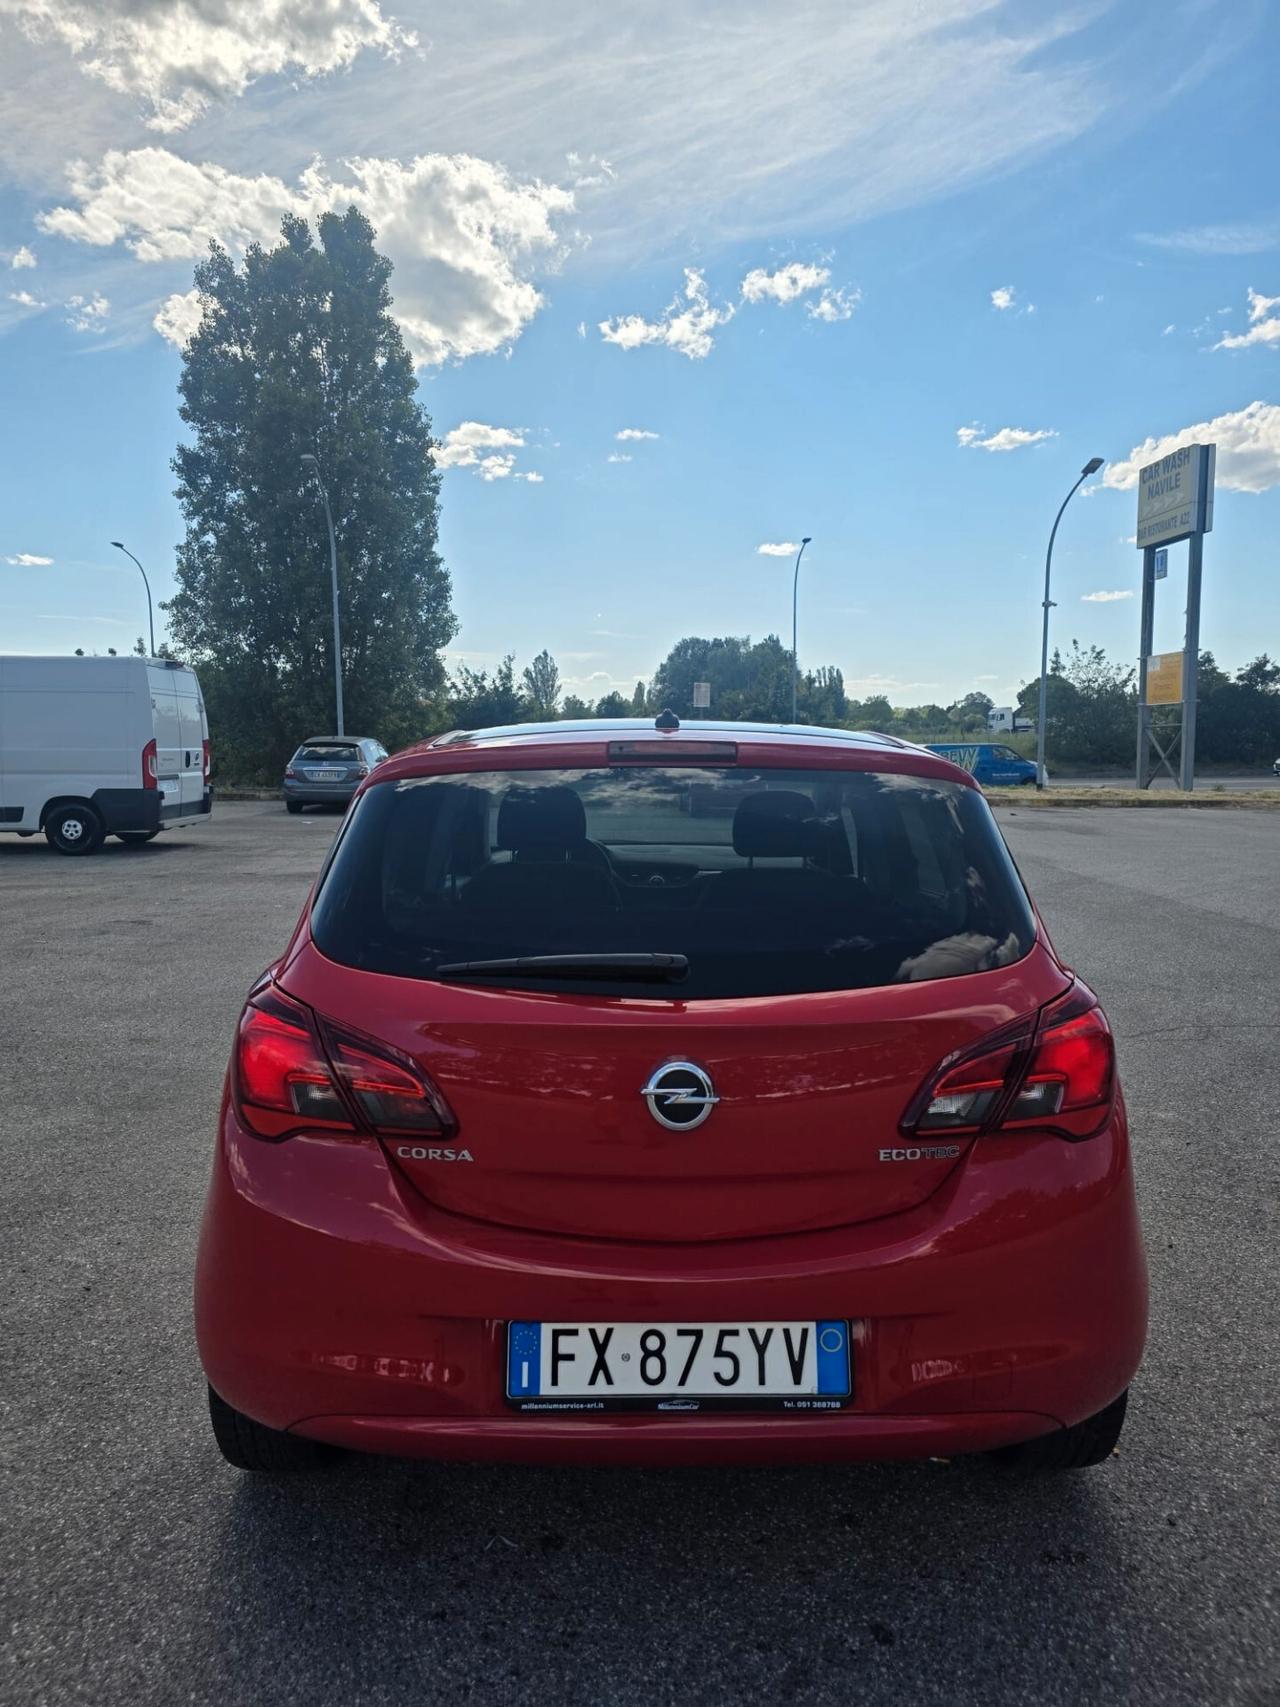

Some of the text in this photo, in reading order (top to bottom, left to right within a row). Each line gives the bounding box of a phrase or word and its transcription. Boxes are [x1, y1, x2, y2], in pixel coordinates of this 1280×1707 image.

[1142, 450, 1190, 484] CAR WASH
[1148, 472, 1181, 500] NAVILE
[397, 1146, 474, 1162] CORSA
[879, 1146, 960, 1161] ECOTEC
[551, 1327, 614, 1387] FX
[639, 1327, 809, 1387] 875YV
